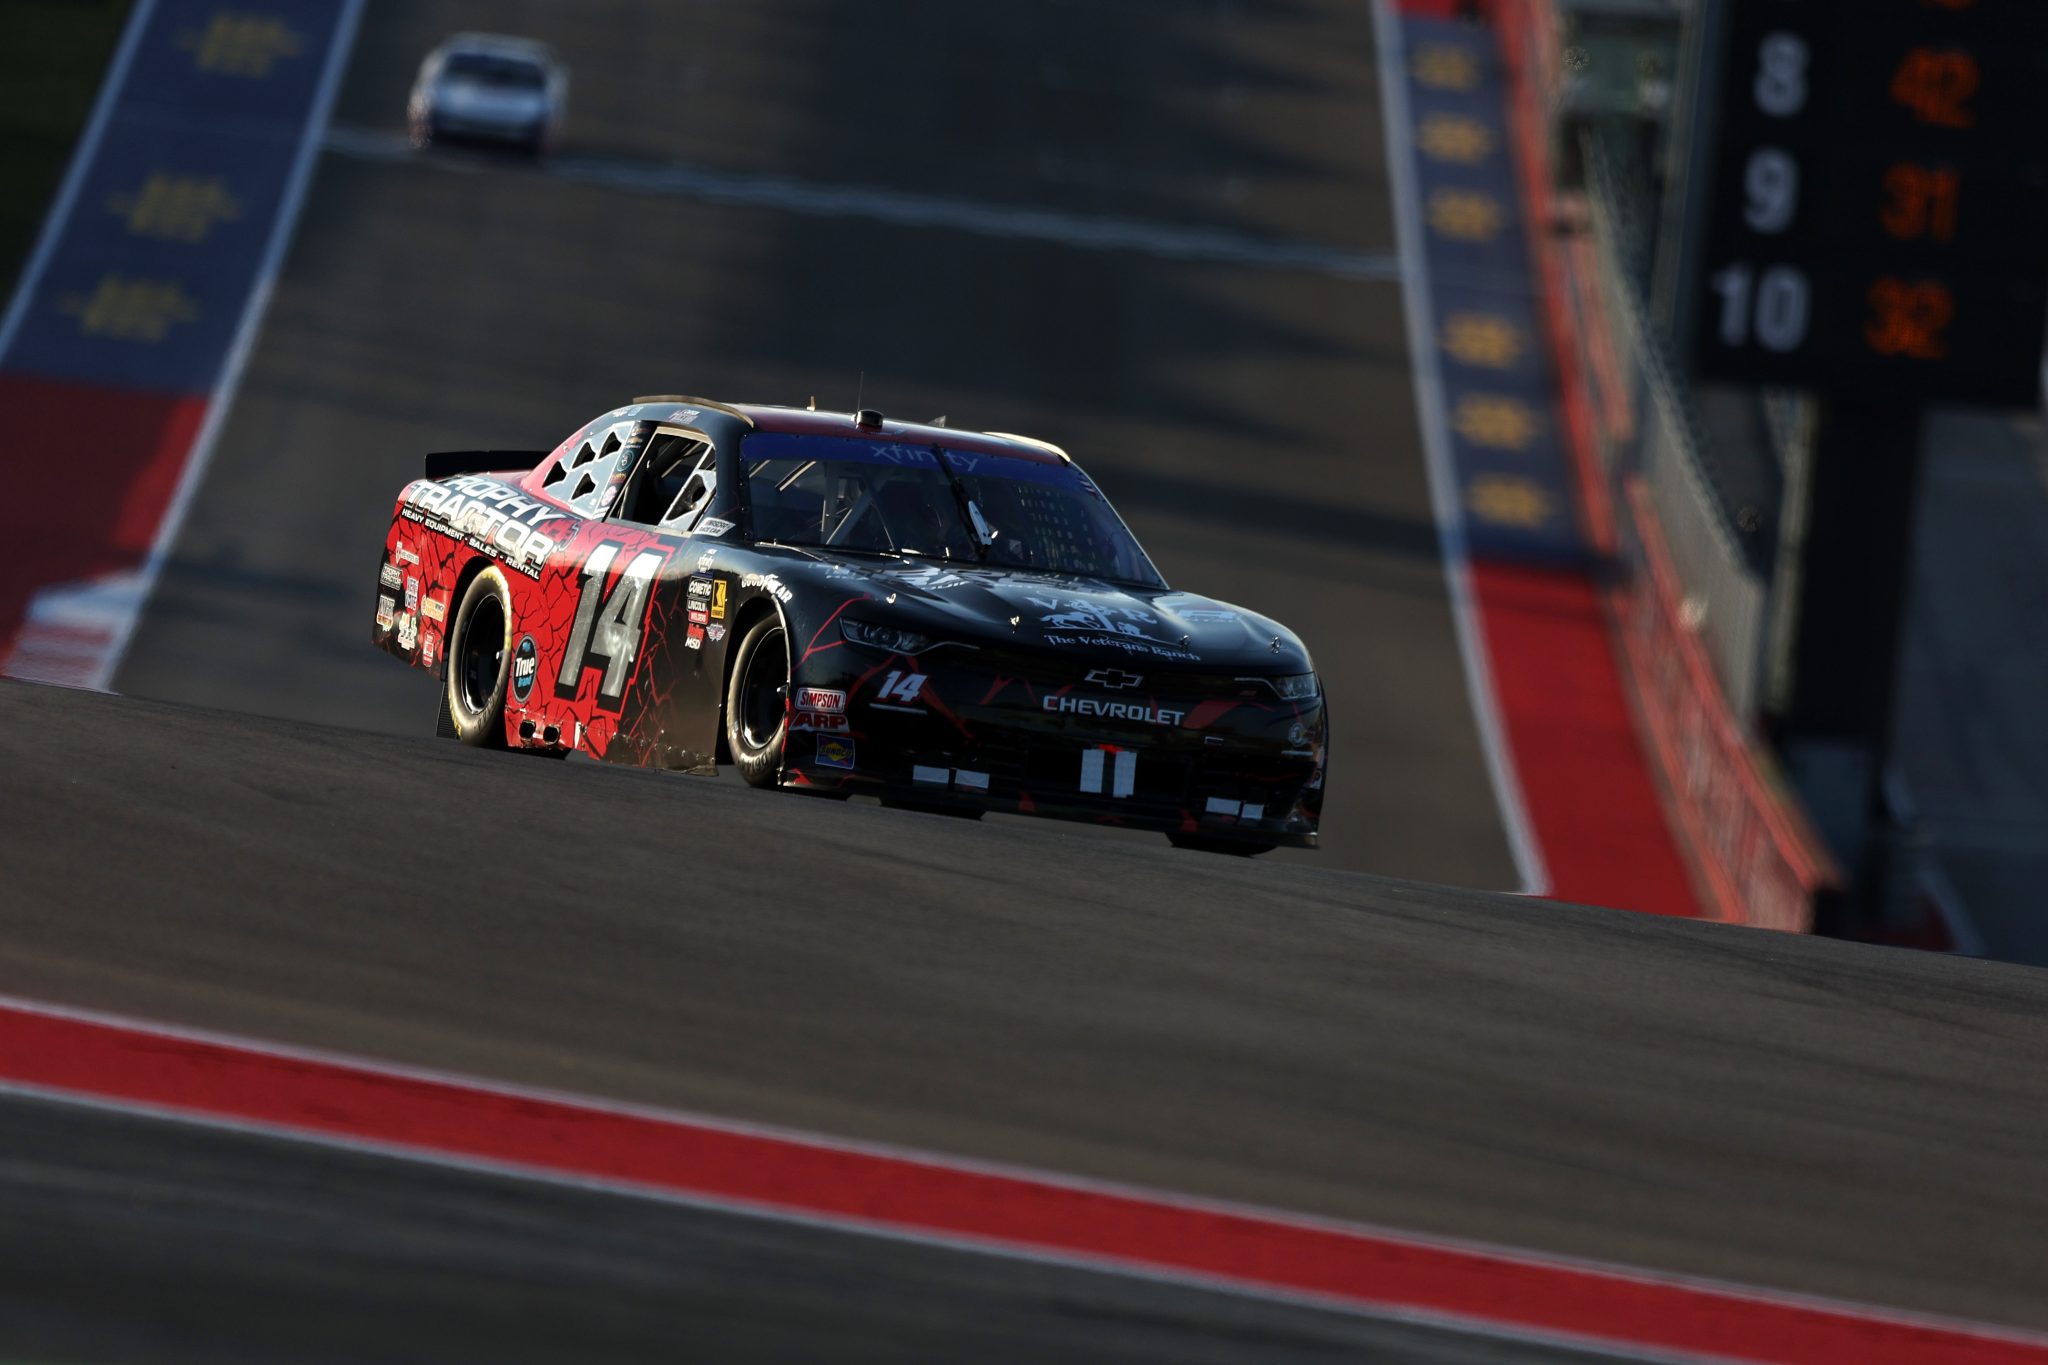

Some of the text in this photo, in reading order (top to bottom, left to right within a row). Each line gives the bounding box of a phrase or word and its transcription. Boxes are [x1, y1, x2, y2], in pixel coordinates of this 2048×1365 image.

[1755, 31, 1980, 129] 8 42
[1743, 146, 1959, 242] 9 31
[1712, 263, 1955, 358] 10 32
[870, 444, 978, 472] xfinty
[444, 475, 566, 526] ROPHY
[405, 480, 554, 567] TRACTOR
[401, 508, 540, 580] HEAVY EQUIPMENT SALES RENTAL
[558, 544, 663, 698] 14
[685, 637, 701, 650] MSD
[1043, 634, 1201, 662] The Veterans Ranch
[515, 656, 535, 678] True
[801, 691, 841, 708] SIMPSON
[878, 670, 928, 702] 14
[795, 713, 847, 729] ARP
[1042, 696, 1185, 726] CHEVROLET
